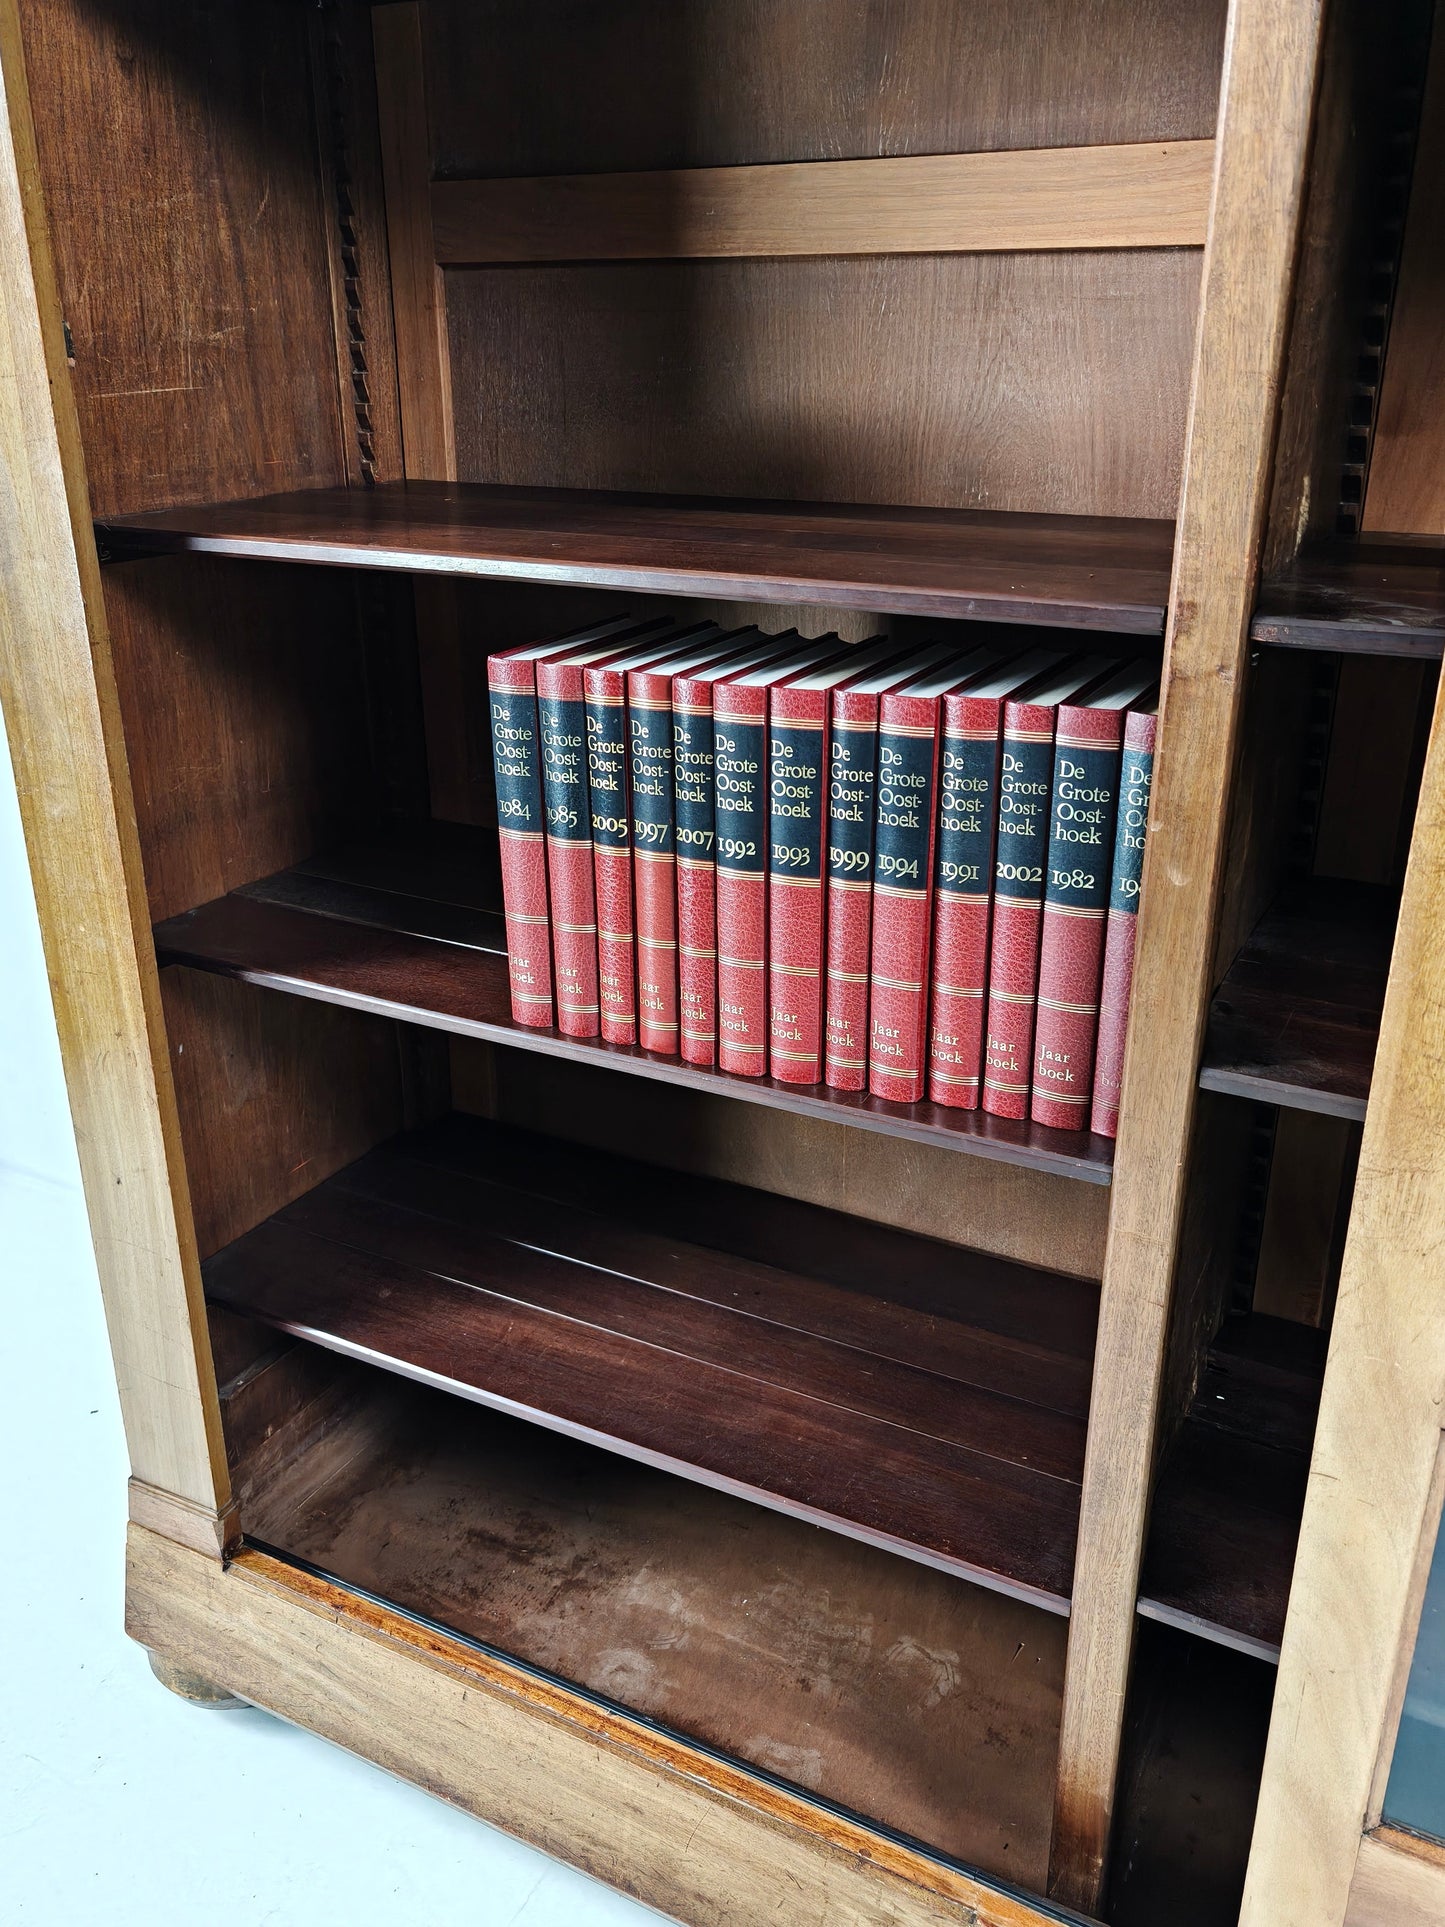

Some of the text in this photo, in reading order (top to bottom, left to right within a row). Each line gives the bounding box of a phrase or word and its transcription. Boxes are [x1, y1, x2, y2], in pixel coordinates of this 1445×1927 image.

[492, 704, 510, 720] De
[542, 711, 559, 727] De
[495, 723, 532, 740] Grote
[586, 716, 603, 734] De
[631, 720, 649, 738] De
[543, 730, 581, 747] Grote
[588, 735, 625, 754] Grote
[674, 726, 692, 744] De
[716, 734, 736, 752] De
[495, 741, 531, 758] Oost-
[544, 748, 580, 765] Oost-
[632, 740, 672, 759] Grote
[674, 746, 713, 765] Grote
[771, 740, 793, 757] De
[832, 742, 851, 761] De
[880, 747, 902, 765] De
[497, 758, 531, 777] hoek
[589, 754, 622, 772] Oost-
[633, 759, 669, 777] Oost-
[716, 754, 758, 773] Grote
[772, 760, 816, 779] Grote
[943, 752, 964, 770] De
[1002, 753, 1024, 773] De
[1059, 760, 1085, 779] De
[545, 764, 579, 784] hoek
[590, 771, 618, 791] hoek
[675, 765, 711, 784] Oost-
[831, 763, 874, 782] Grote
[880, 768, 926, 788] Grote
[942, 772, 989, 792] Grote
[1128, 766, 1153, 785] De
[633, 776, 664, 796] hoek
[716, 773, 756, 792] Oost-
[771, 779, 814, 798] Oost-
[831, 782, 870, 802] Oost-
[1001, 775, 1048, 795] Grote
[675, 782, 706, 803] hoek
[717, 792, 754, 812] hoek
[879, 788, 923, 808] Oost-
[1058, 782, 1110, 803] Grote
[499, 799, 531, 820] 1984
[771, 798, 811, 818] hoek
[830, 801, 864, 822] hoek
[941, 793, 985, 812] Oost-
[1000, 795, 1043, 816] Oost-
[547, 806, 578, 828] 1985
[878, 806, 919, 828] hoek
[941, 812, 981, 833] hoek
[1056, 803, 1106, 824] Oost-
[592, 815, 628, 838] 2005
[634, 819, 668, 843] 1997
[999, 814, 1036, 836] hoek
[1055, 822, 1102, 844] hoek
[676, 828, 714, 850] 2007
[718, 837, 756, 859] 1992
[1123, 829, 1146, 850] ho
[772, 844, 811, 867] 1993
[830, 846, 870, 872] 1999
[878, 854, 919, 879] 1994
[940, 861, 980, 884] 1991
[996, 862, 1042, 882] 2002
[1052, 869, 1095, 890] 1982
[559, 965, 578, 977] aar
[720, 998, 744, 1015] Jaar
[771, 1007, 798, 1024] Jaar
[720, 1015, 750, 1033] boek
[826, 1011, 851, 1030] Jaar
[872, 1019, 900, 1039] Jaar
[771, 1022, 802, 1041] boek
[826, 1028, 855, 1047] boek
[932, 1027, 959, 1046] Jaar
[872, 1037, 905, 1057] boek
[987, 1034, 1015, 1053] Jaar
[932, 1044, 963, 1064] boek
[986, 1051, 1019, 1071] boek
[1039, 1045, 1070, 1064] Jaar
[1038, 1061, 1075, 1082] boek
